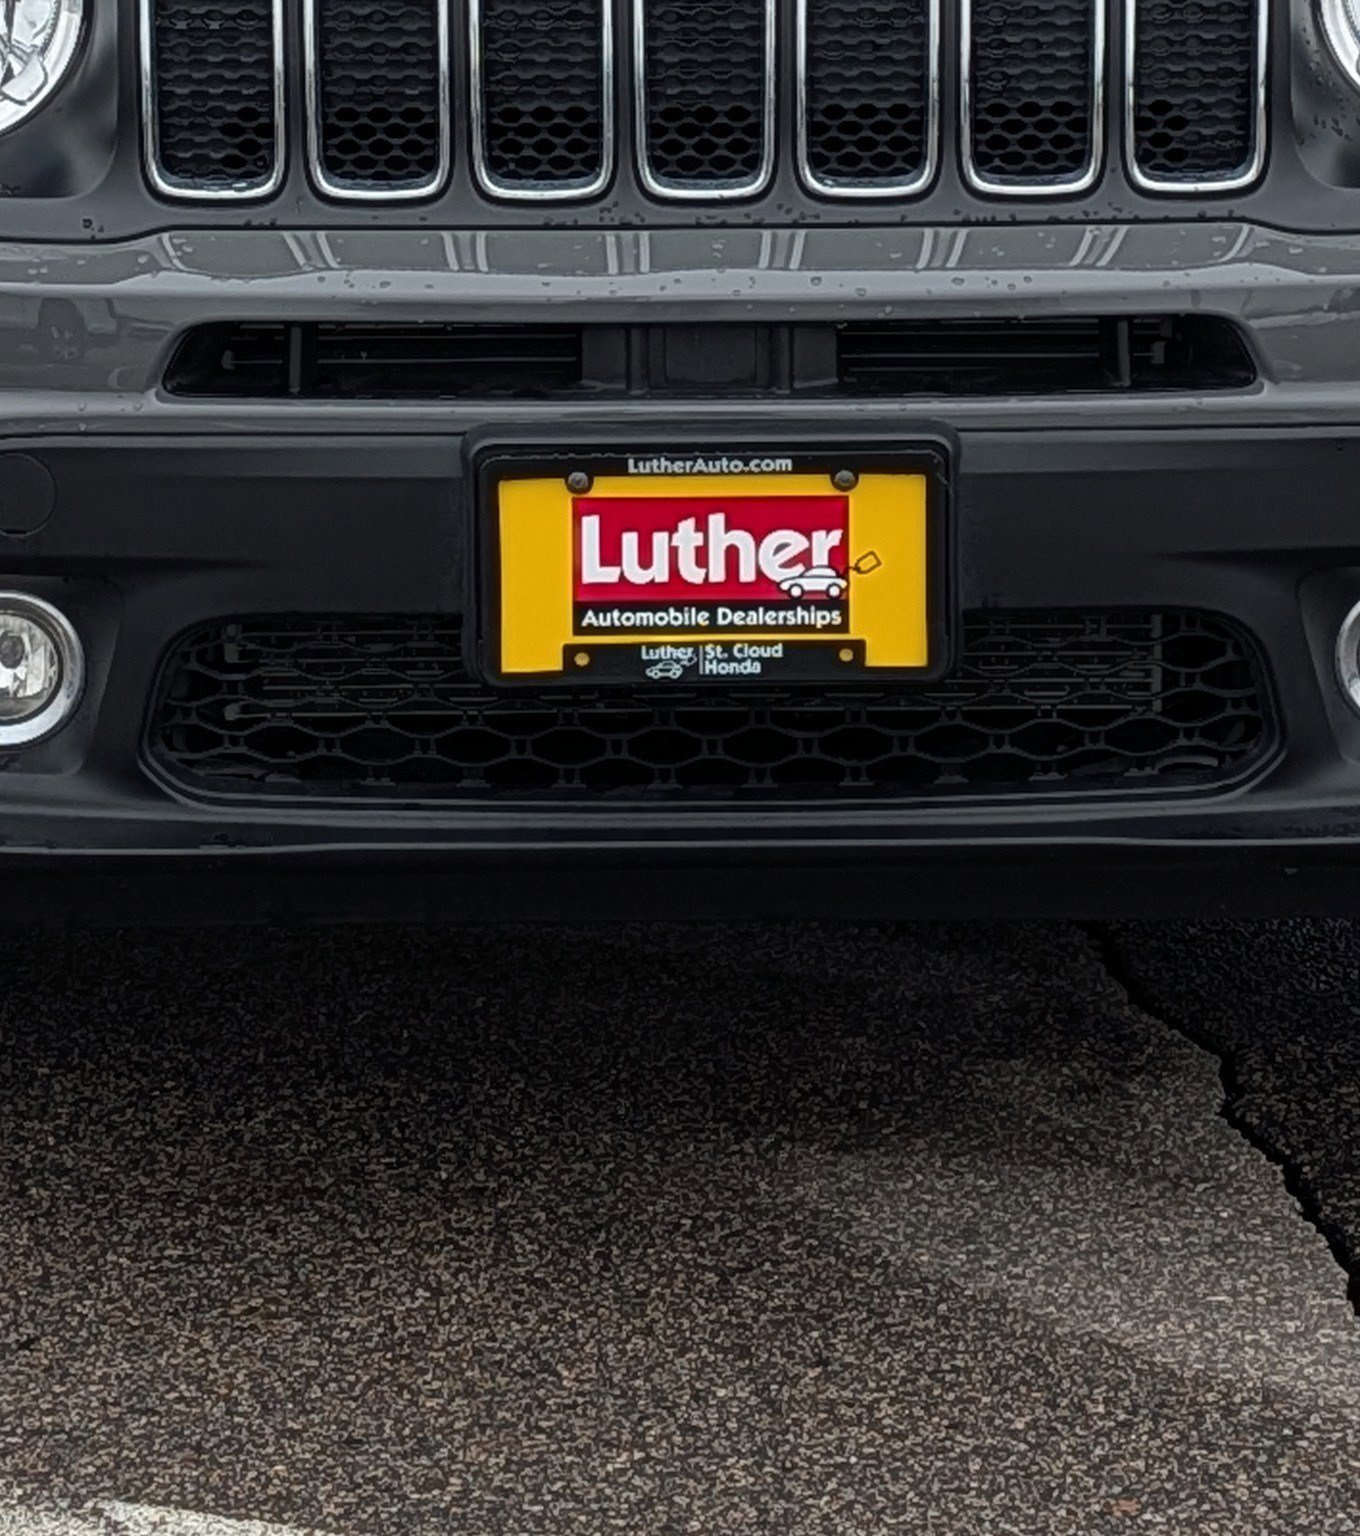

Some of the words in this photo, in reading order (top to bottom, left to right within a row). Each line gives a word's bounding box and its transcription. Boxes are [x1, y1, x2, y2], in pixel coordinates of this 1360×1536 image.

[627, 457, 792, 474] LutherAuto.com
[580, 512, 843, 585] Luther
[581, 606, 710, 628] Automobile
[717, 605, 842, 629] Dealerships
[641, 645, 695, 660] Luther
[705, 644, 729, 659] St.
[733, 643, 783, 658] Cloud
[705, 658, 761, 675] Honda
